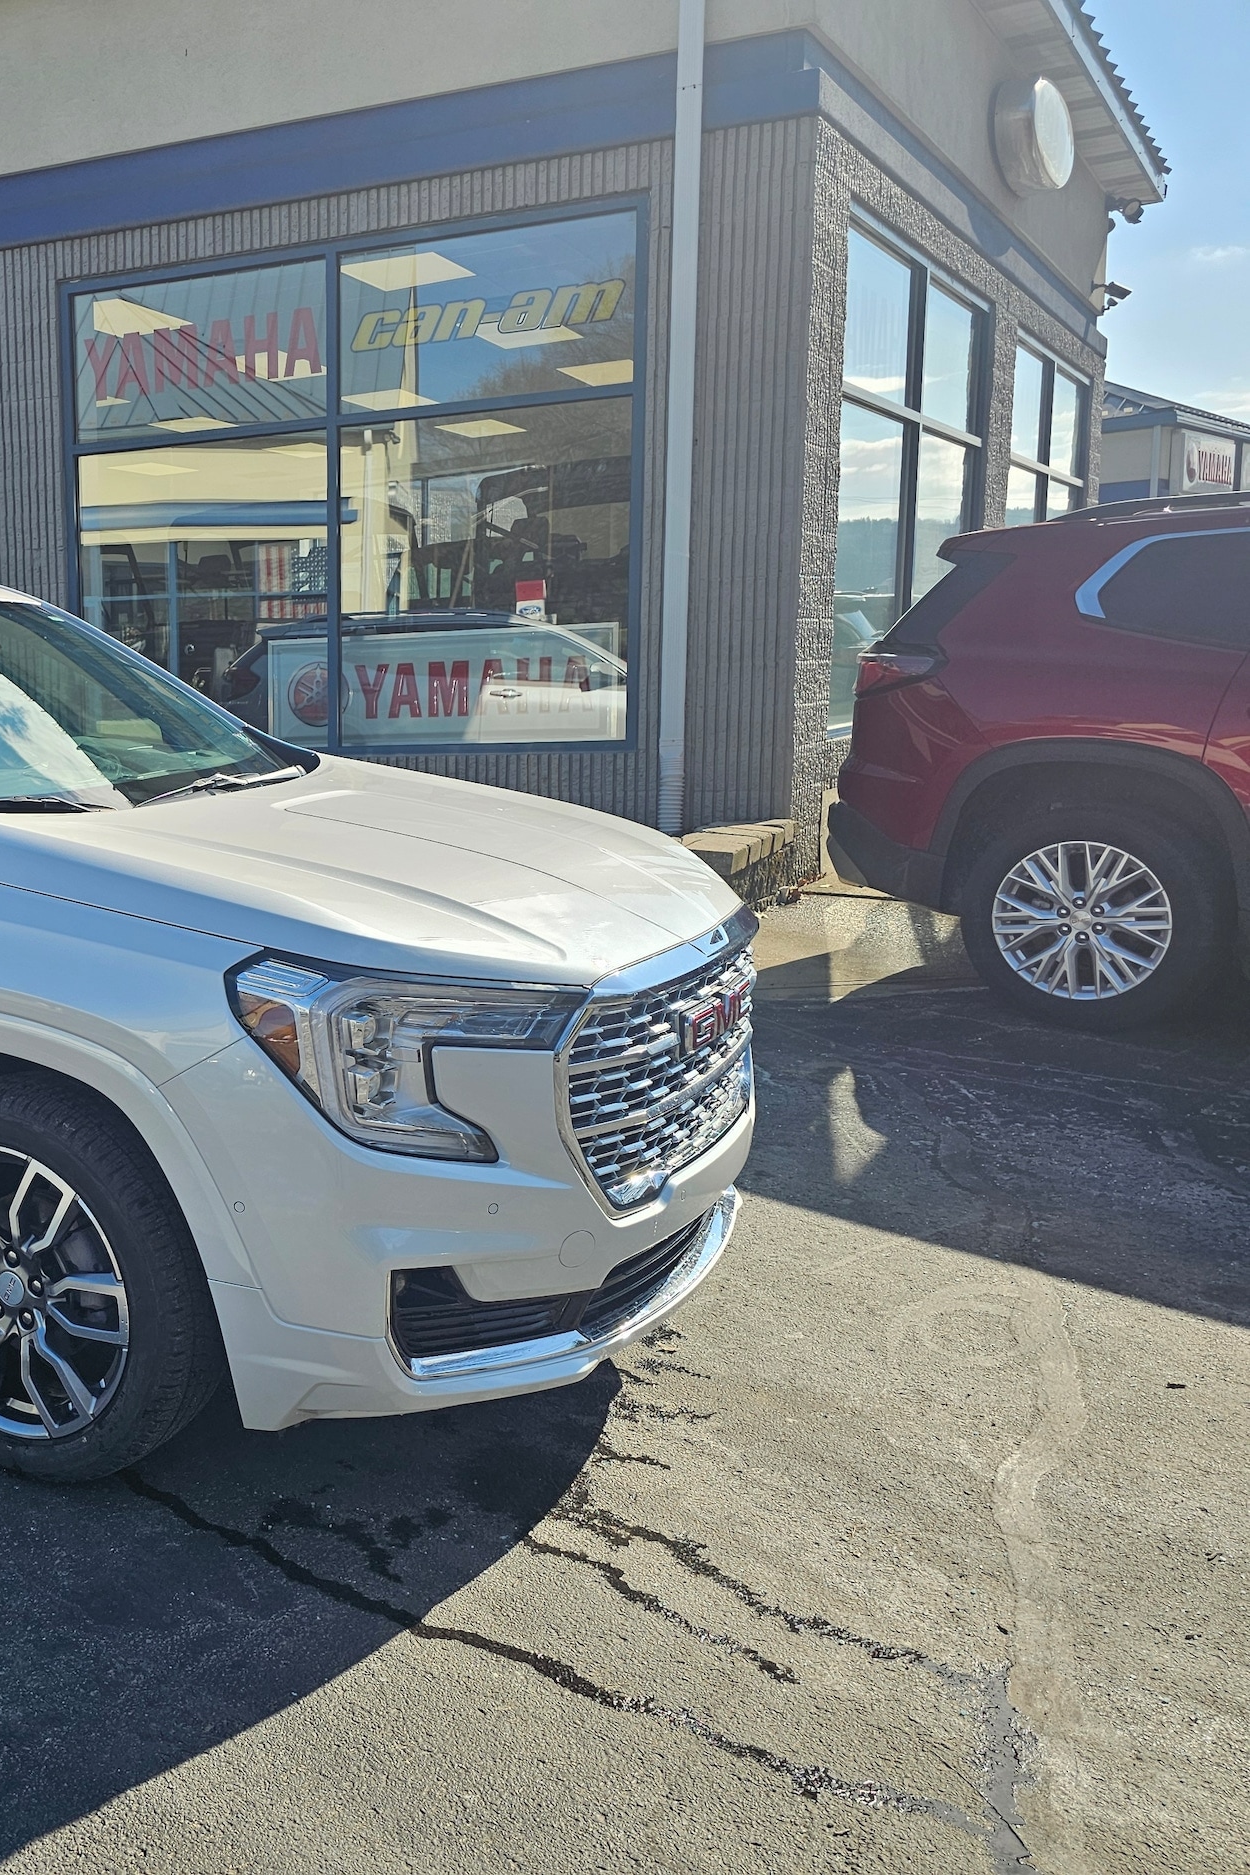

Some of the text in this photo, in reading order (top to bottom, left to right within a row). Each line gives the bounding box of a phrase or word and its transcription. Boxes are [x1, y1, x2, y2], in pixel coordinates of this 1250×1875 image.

[350, 277, 626, 352] can-am
[83, 306, 323, 401] YAMAHA
[1198, 450, 1232, 485] YAMAHA
[354, 655, 594, 719] YAMAHA
[686, 979, 751, 1051] GMC
